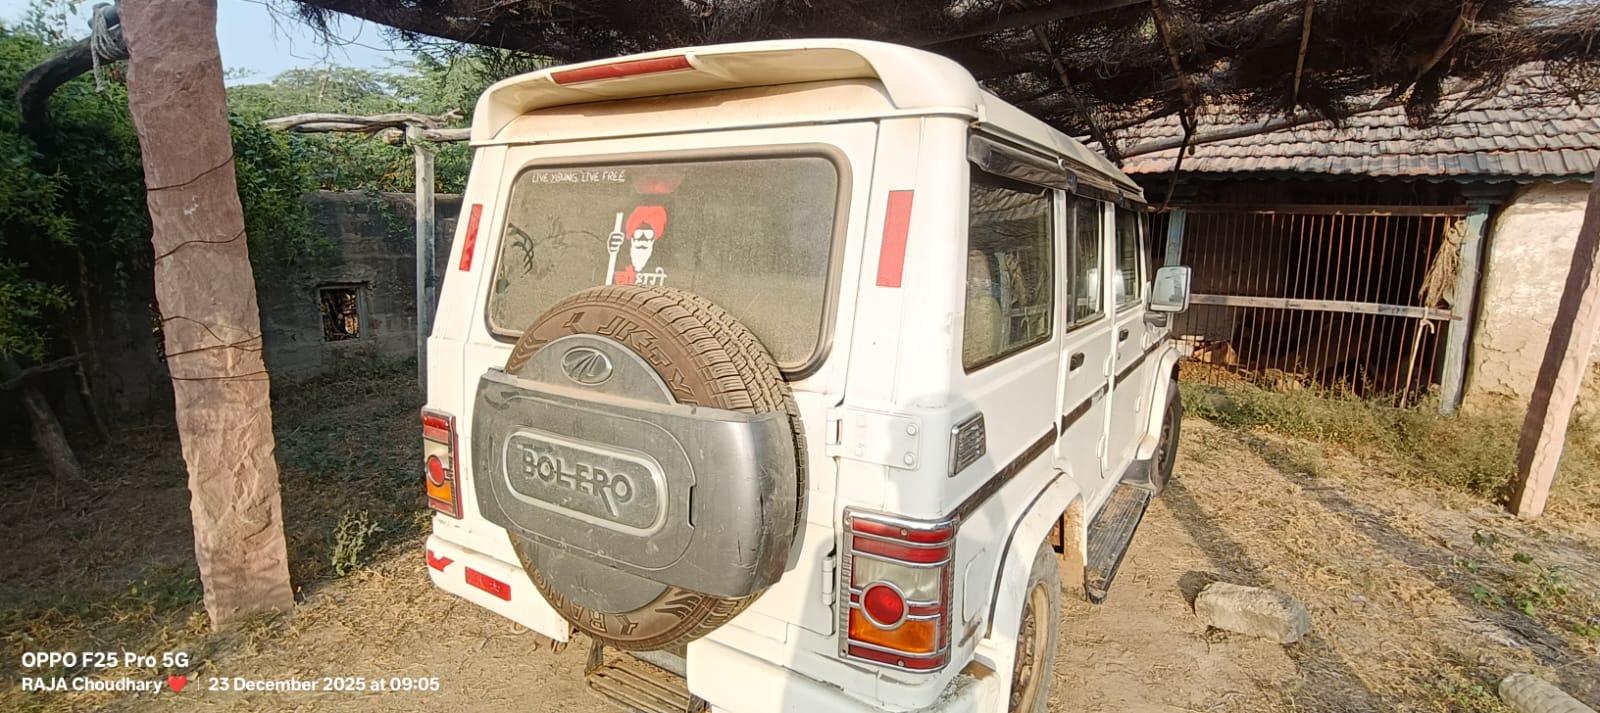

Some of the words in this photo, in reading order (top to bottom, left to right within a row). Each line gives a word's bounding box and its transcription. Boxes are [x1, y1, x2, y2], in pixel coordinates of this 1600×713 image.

[532, 172, 549, 183] LIVE
[550, 172, 578, 183] YOUNG
[581, 171, 600, 183] LIVE
[602, 168, 626, 183] FREE
[521, 447, 634, 518] BOLERO
